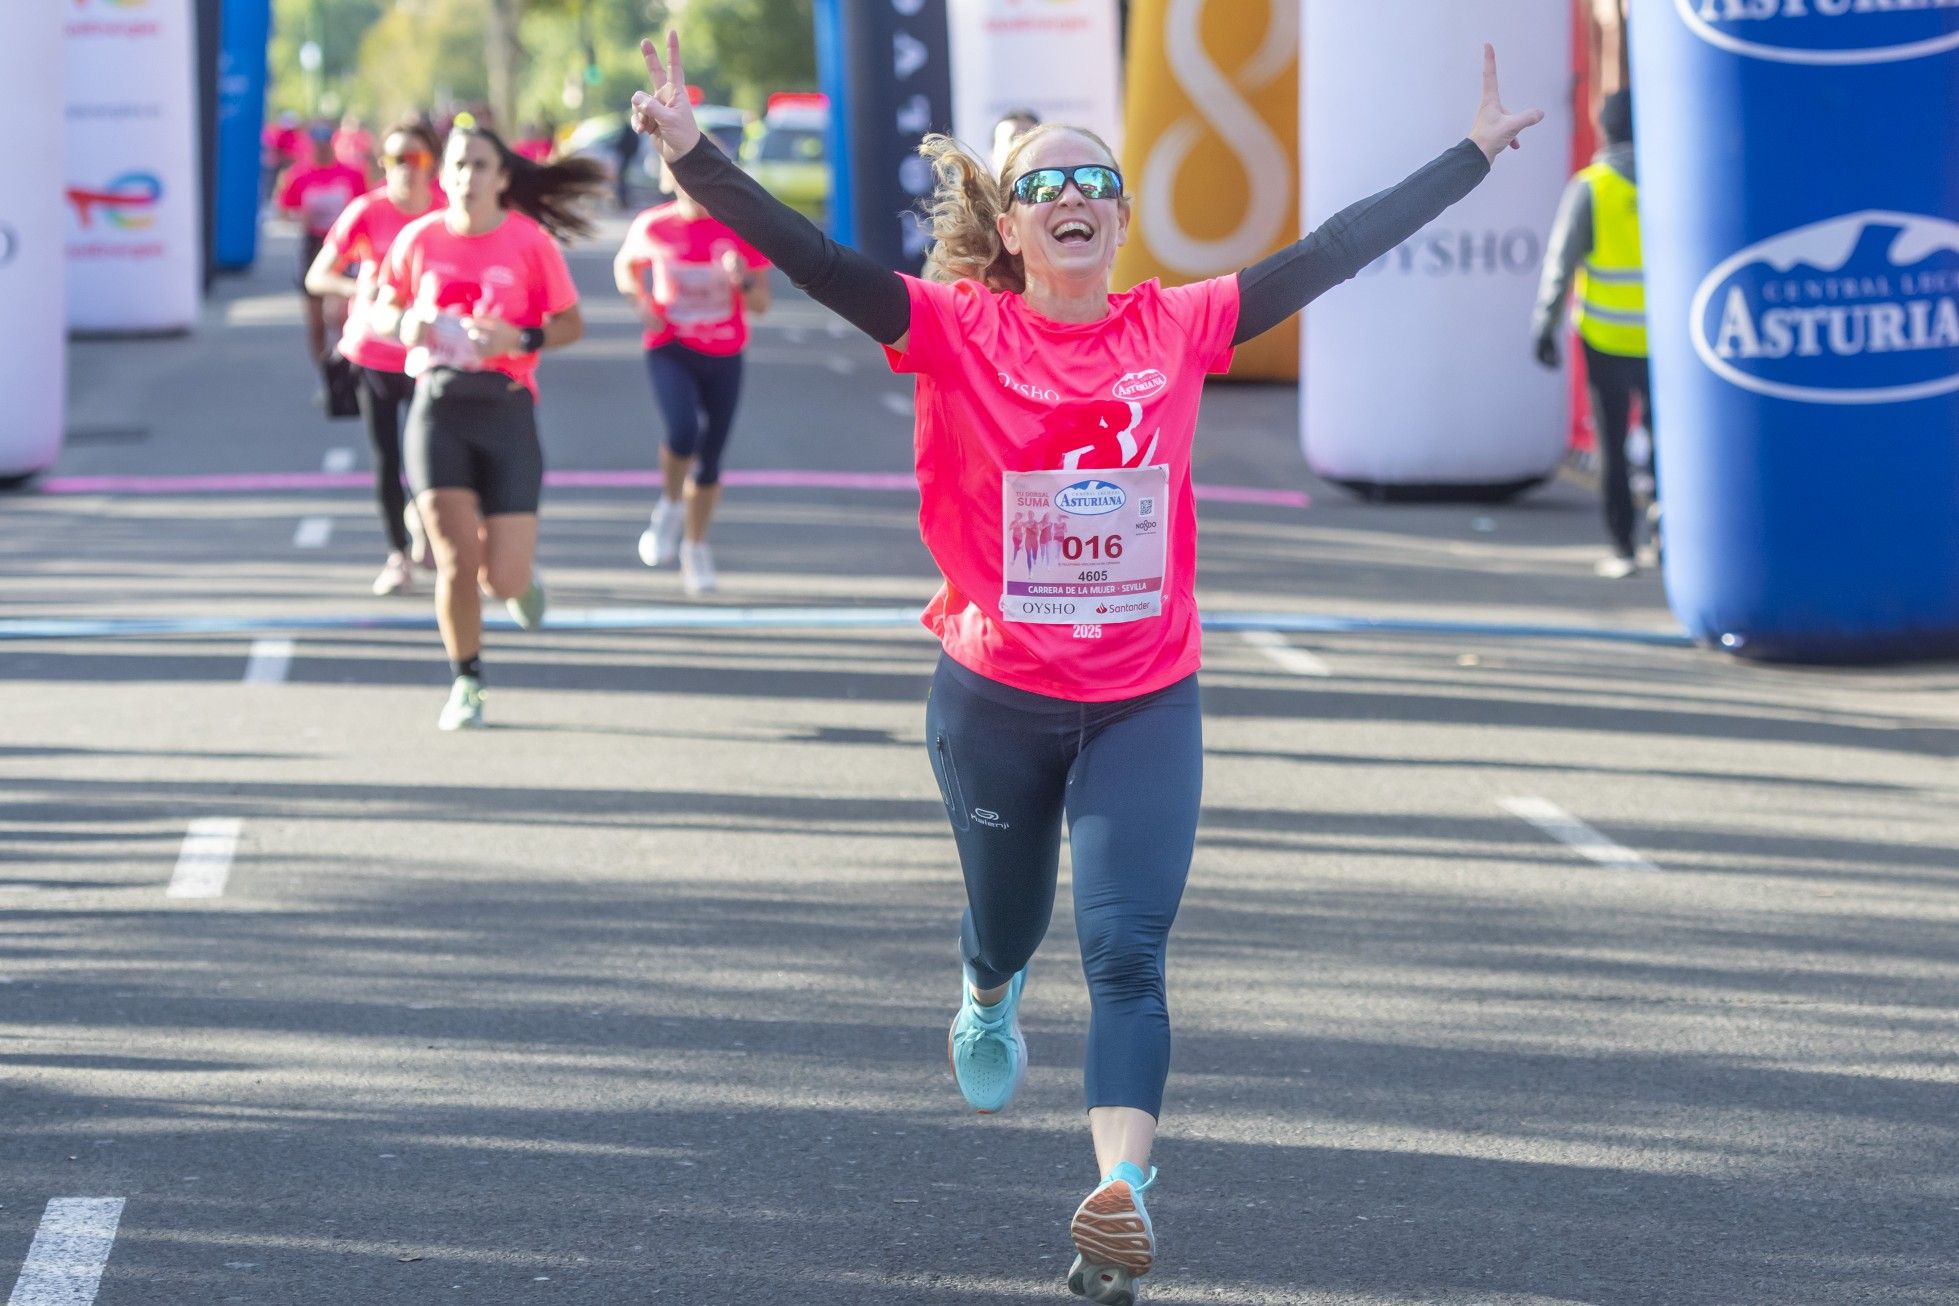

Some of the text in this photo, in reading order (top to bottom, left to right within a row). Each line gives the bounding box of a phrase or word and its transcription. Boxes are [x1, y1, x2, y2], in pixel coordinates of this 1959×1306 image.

[1360, 225, 1541, 278] YSHO
[1761, 275, 1890, 303] CENTRAL
[1118, 377, 1163, 396] ASTURIANA
[1017, 497, 1050, 507] SUMA
[1060, 493, 1122, 507] ASTURIANA
[1062, 534, 1123, 560] 016
[1078, 570, 1108, 581] 4605
[1028, 582, 1147, 595] CARRERA DE LA MUJER SEVILLA
[1022, 601, 1151, 615] OYSHO Santander
[1072, 624, 1103, 639] 2025
